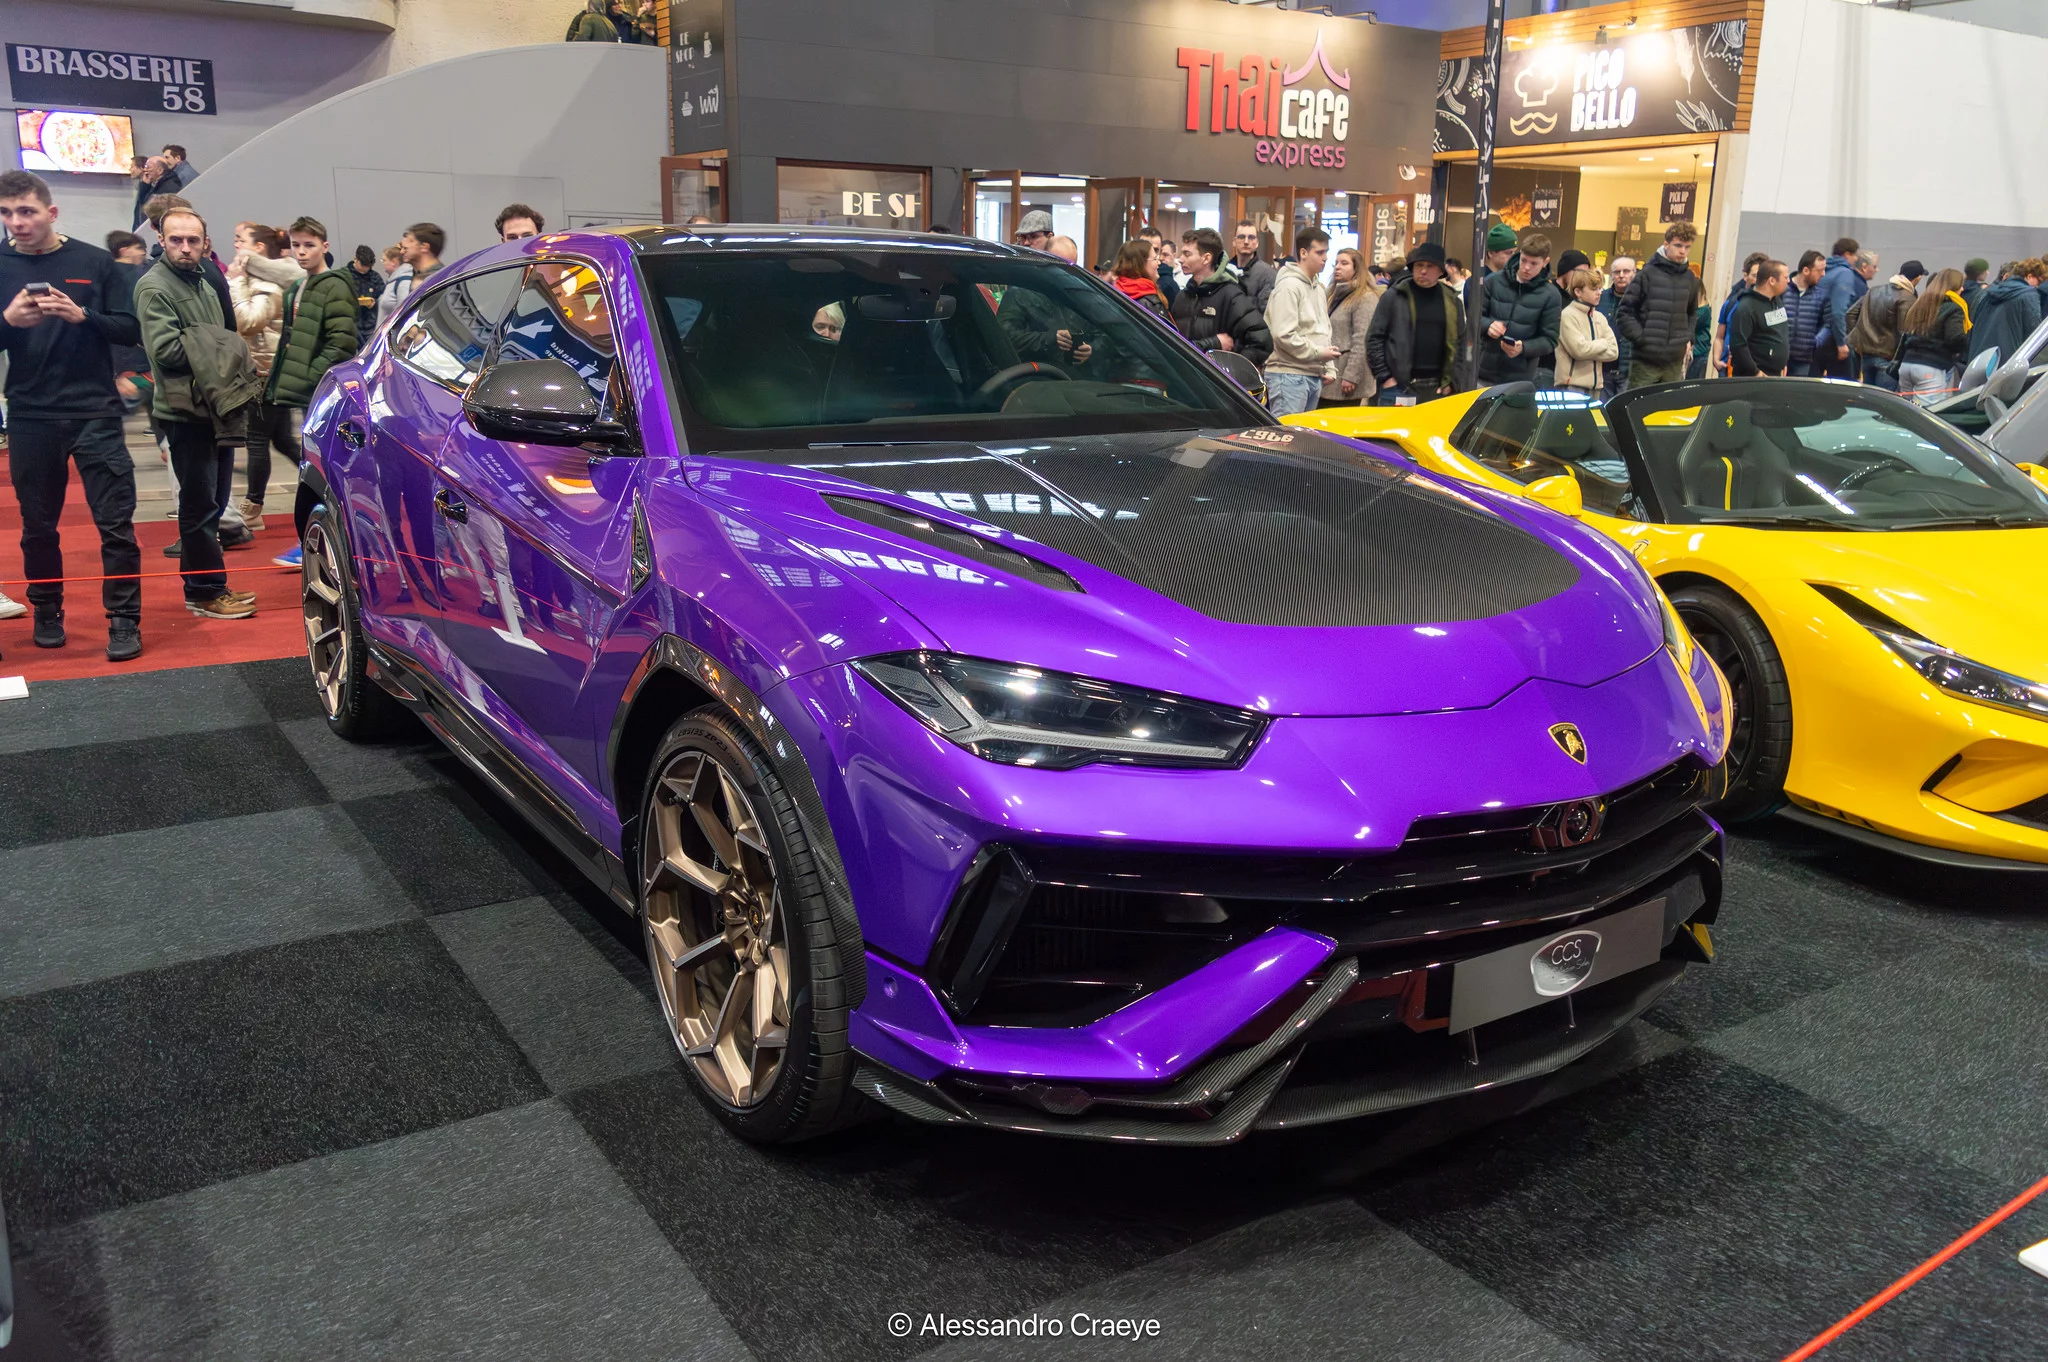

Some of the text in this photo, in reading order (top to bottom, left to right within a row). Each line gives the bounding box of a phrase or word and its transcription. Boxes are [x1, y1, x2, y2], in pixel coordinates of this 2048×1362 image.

[16, 46, 205, 86] BRASSERIE
[1573, 48, 1625, 93] PICO
[162, 85, 206, 112] 58
[1178, 46, 1281, 138] Thai
[1570, 87, 1637, 132] BELLO
[1255, 140, 1346, 168] express
[842, 191, 882, 217] BE
[1551, 939, 1582, 965] CCS
